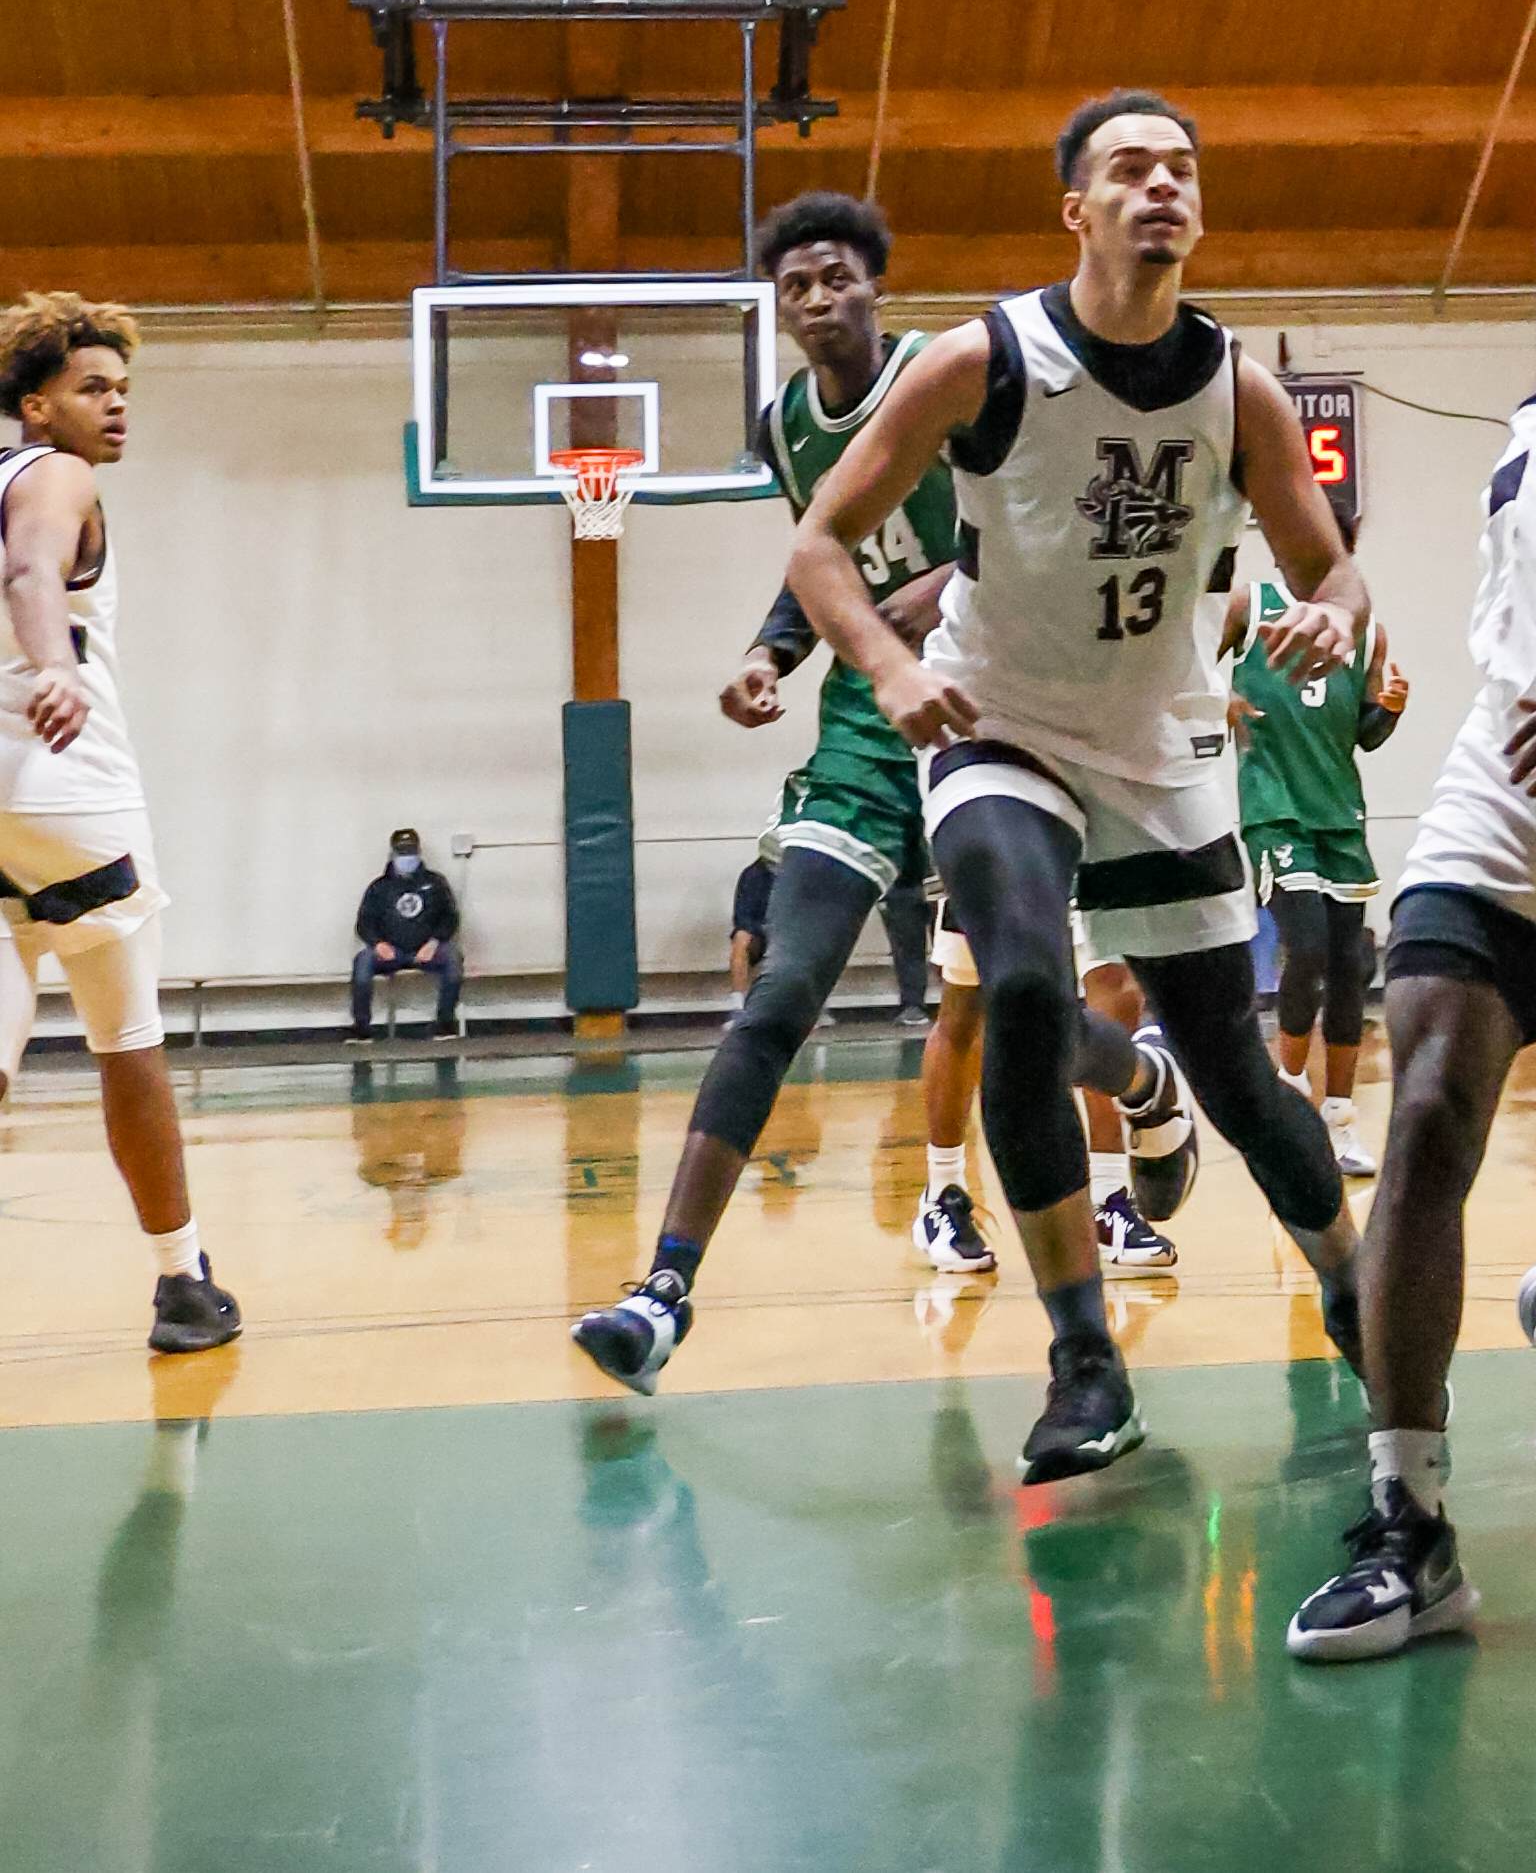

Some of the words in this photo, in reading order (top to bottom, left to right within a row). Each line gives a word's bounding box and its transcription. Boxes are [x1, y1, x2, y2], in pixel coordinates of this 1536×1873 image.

[1295, 393, 1351, 418] ITOR
[859, 505, 932, 585] 34
[1097, 566, 1167, 640] 13
